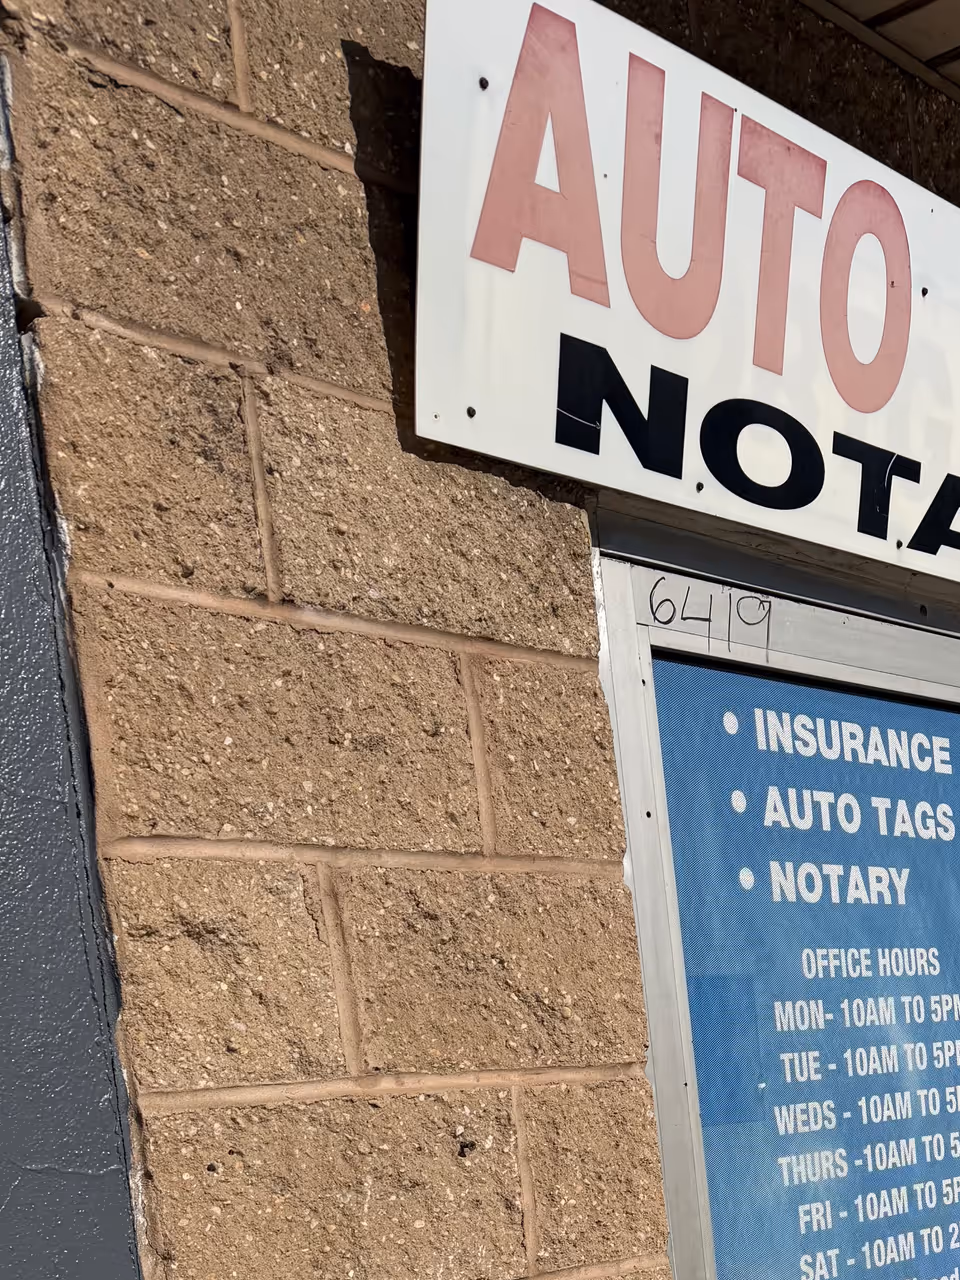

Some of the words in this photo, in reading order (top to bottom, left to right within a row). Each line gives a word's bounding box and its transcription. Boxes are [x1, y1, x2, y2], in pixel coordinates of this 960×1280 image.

[469, 1, 912, 414] AUTO
[650, 577, 772, 664] 6419
[754, 708, 952, 774] INSURANCE
[764, 786, 861, 833] AUTO
[872, 796, 955, 841] TAGS
[769, 861, 909, 905] NOTARY
[802, 948, 872, 979] OFFICE
[878, 948, 940, 976] HOURS
[841, 996, 896, 1027] 10AM
[901, 995, 925, 1024] TO
[780, 1051, 821, 1083] TUE
[843, 1045, 899, 1078] 10AM
[904, 1043, 927, 1071] TO
[774, 1102, 836, 1136] WEDS
[857, 1093, 912, 1125] 10AM
[917, 1088, 939, 1117] TO
[778, 1148, 848, 1187] THURS
[922, 1133, 944, 1163] TO
[799, 1202, 832, 1234] FRI
[855, 1187, 908, 1223] 10AM
[914, 1181, 936, 1210] TO
[861, 1232, 915, 1270] 10AM
[921, 1227, 943, 1255] TO
